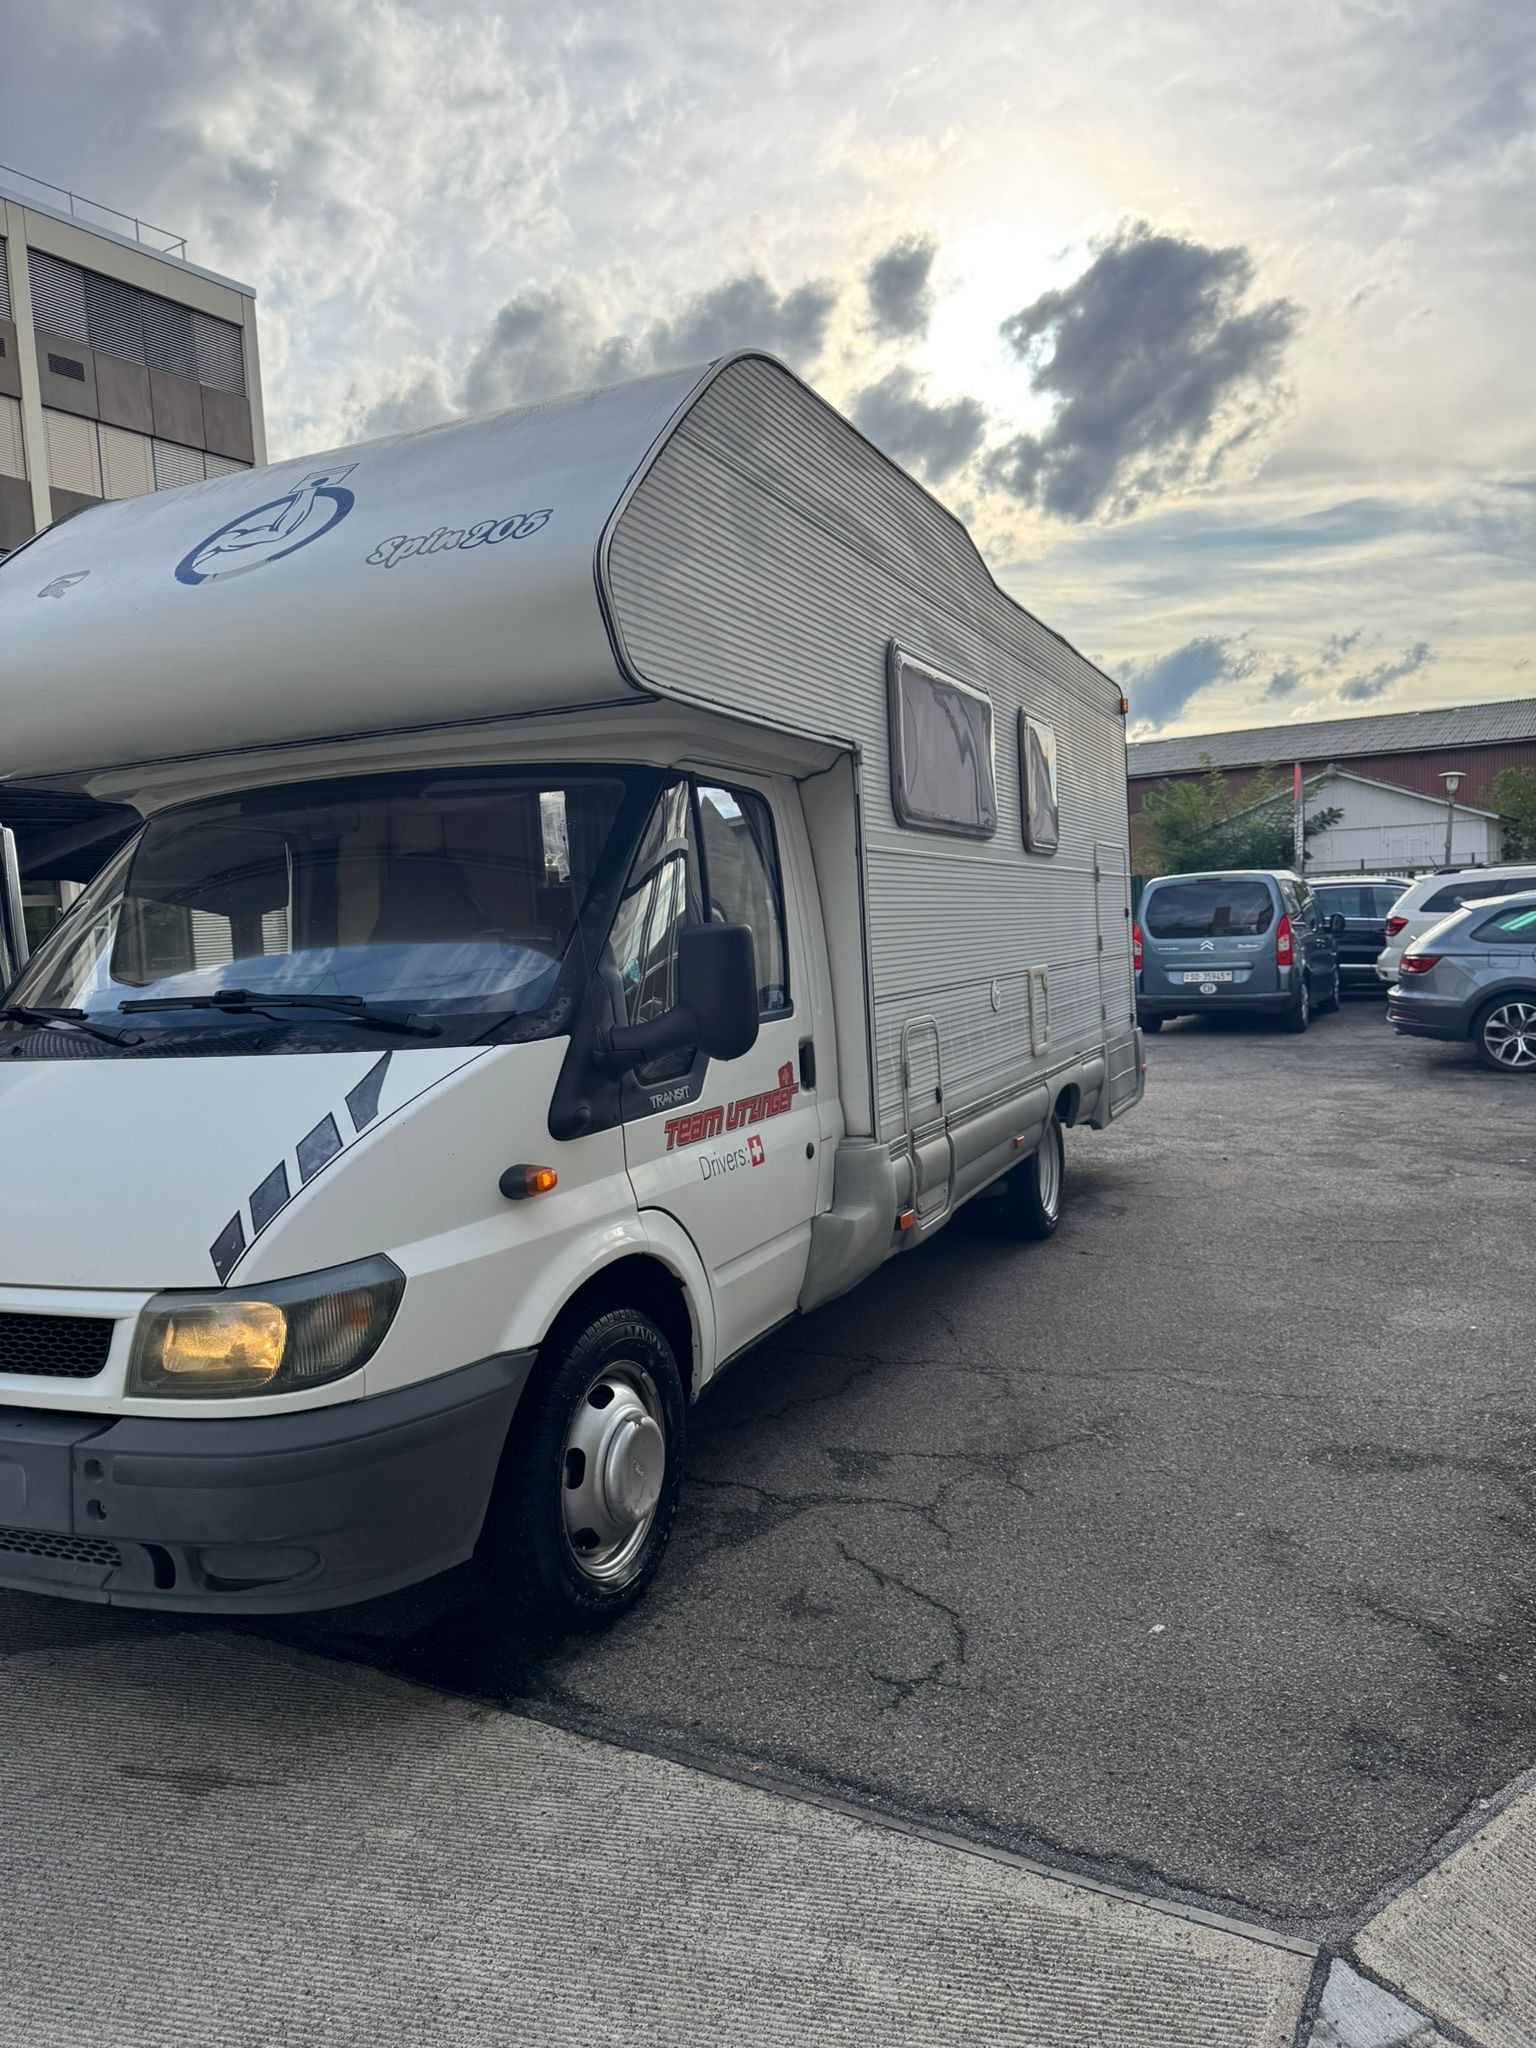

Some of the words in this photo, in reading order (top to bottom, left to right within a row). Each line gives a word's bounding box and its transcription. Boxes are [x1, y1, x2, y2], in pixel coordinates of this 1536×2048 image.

[1203, 985, 1213, 993] CH
[650, 1085, 690, 1109] TRANSIT
[699, 1146, 751, 1181] Drivers:
